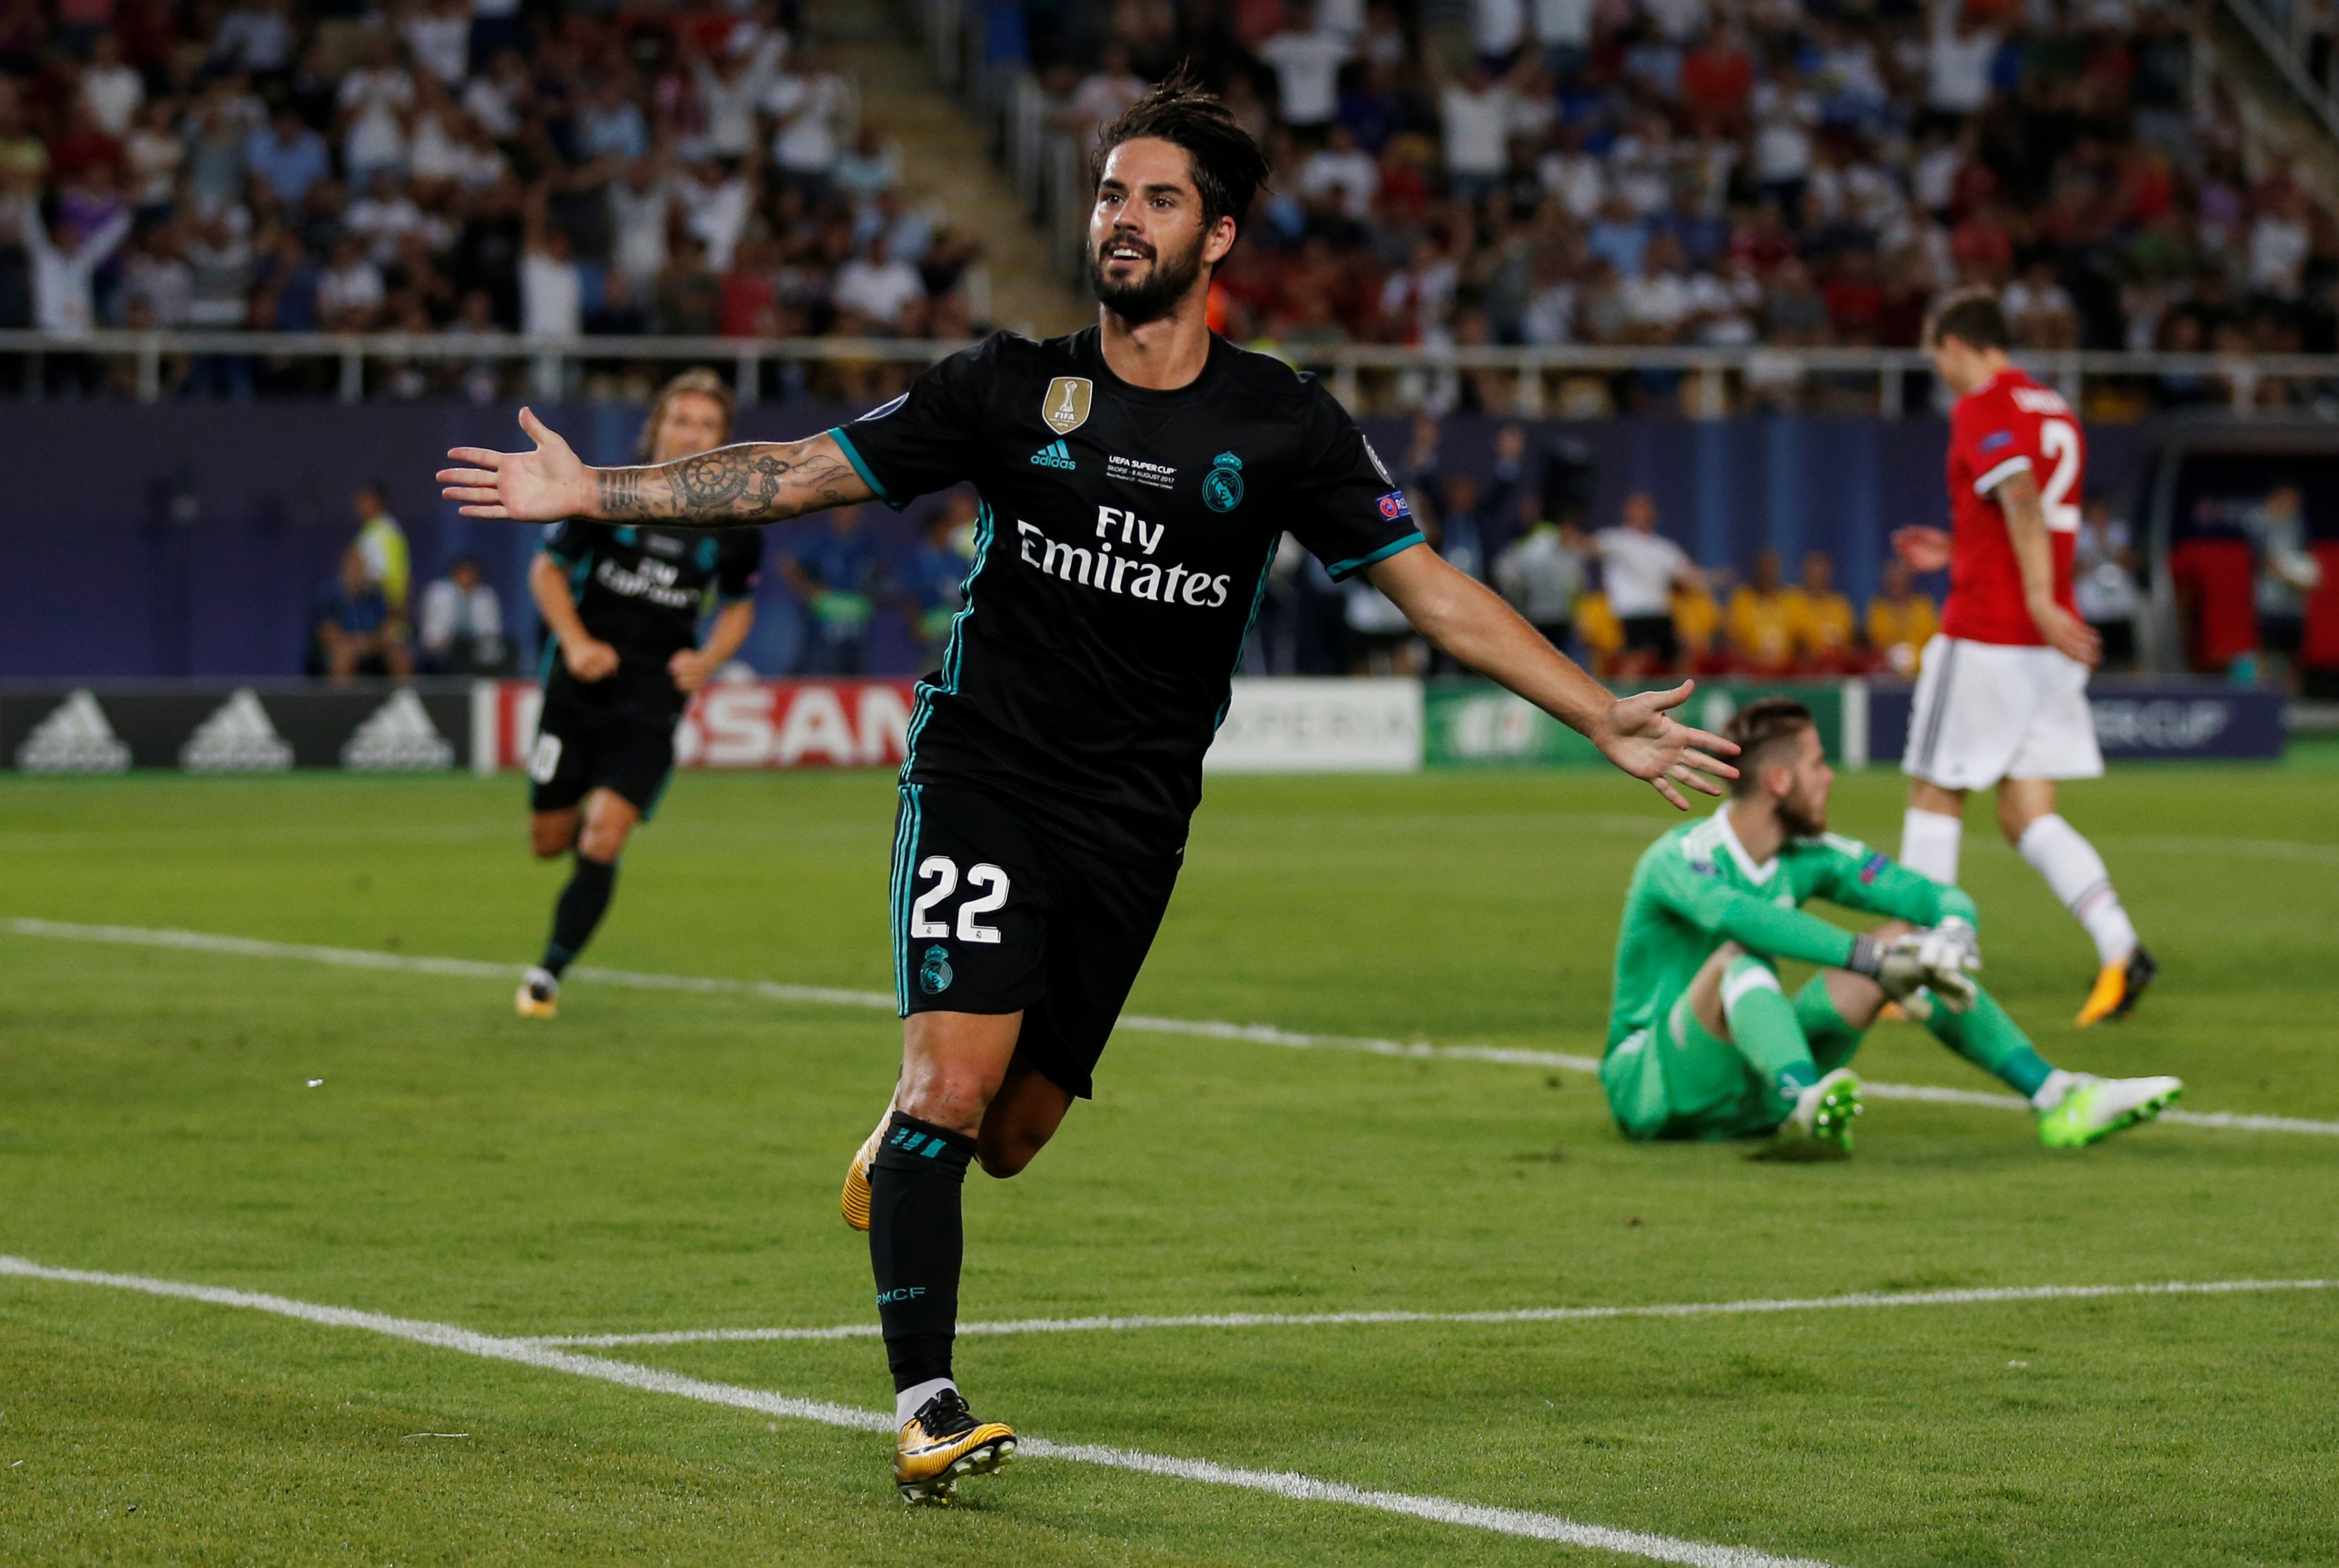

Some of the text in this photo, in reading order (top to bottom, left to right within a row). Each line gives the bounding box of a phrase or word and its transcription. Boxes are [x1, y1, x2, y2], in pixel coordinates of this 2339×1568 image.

[1055, 411, 1075, 420] FIFA
[1030, 455, 1076, 470] adidas
[1109, 456, 1174, 475] UEFA SUPER CUP
[1136, 471, 1160, 480] AUGUST
[2040, 418, 2082, 532] 2
[1096, 505, 1165, 556] Fly
[1017, 519, 1231, 608] Emirates
[910, 855, 1010, 943] 22
